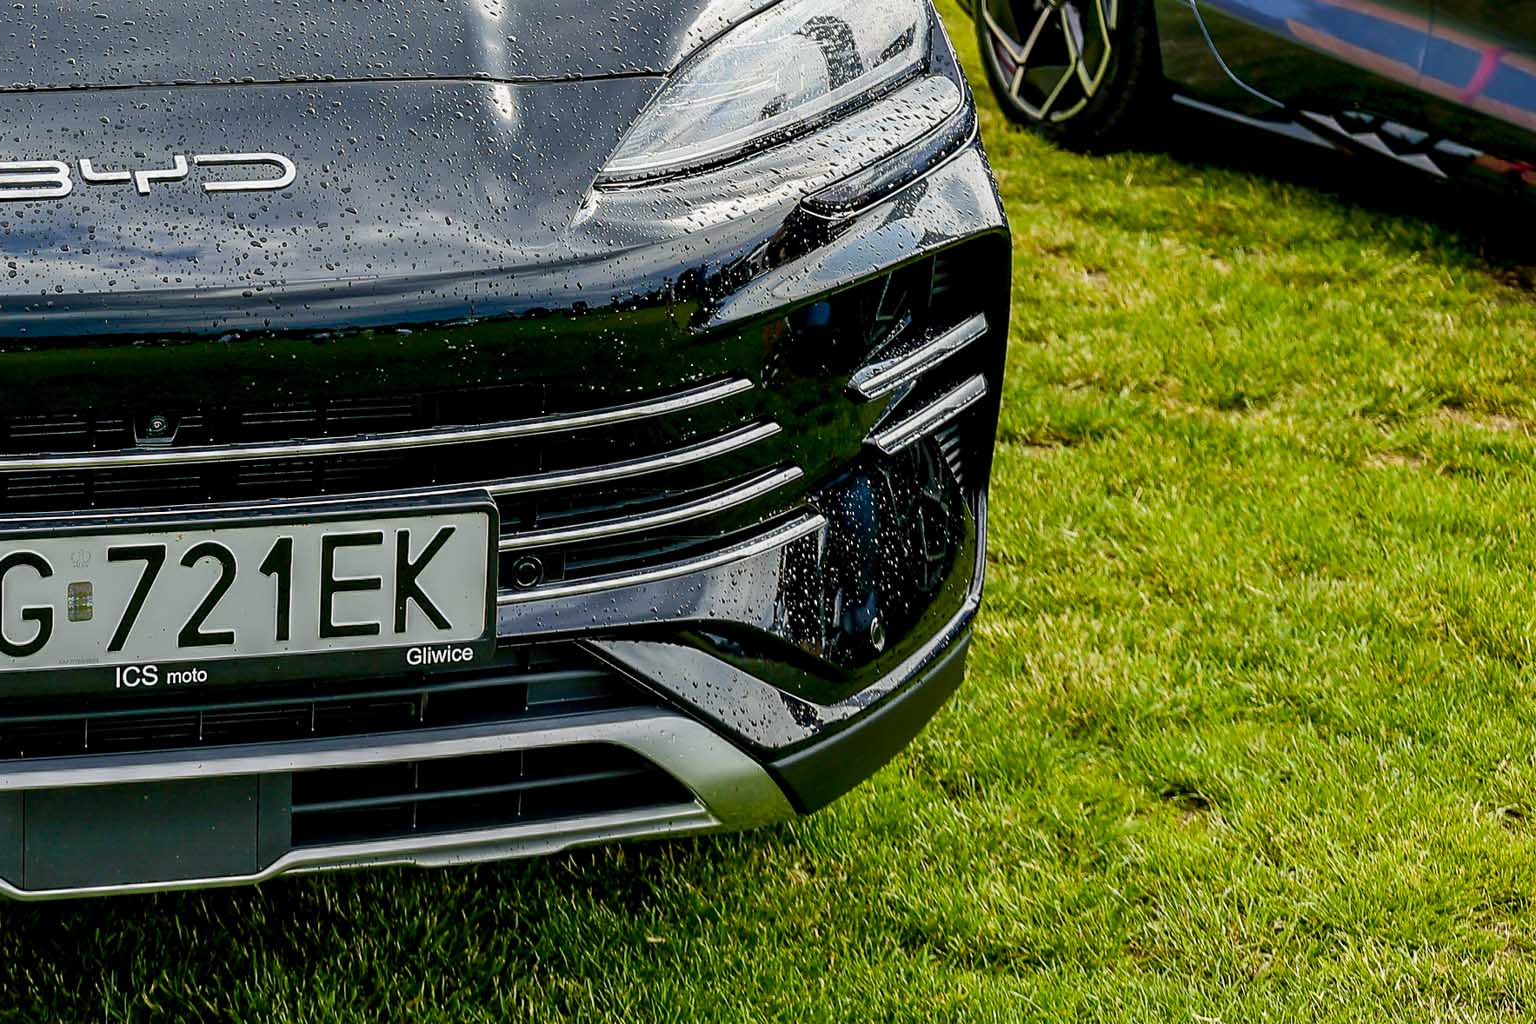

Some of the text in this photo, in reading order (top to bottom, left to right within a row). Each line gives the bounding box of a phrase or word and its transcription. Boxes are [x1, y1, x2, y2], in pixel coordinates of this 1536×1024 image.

[106, 525, 457, 653] 721EK
[406, 645, 474, 666] Gliwice
[115, 665, 208, 688] ICS moto
